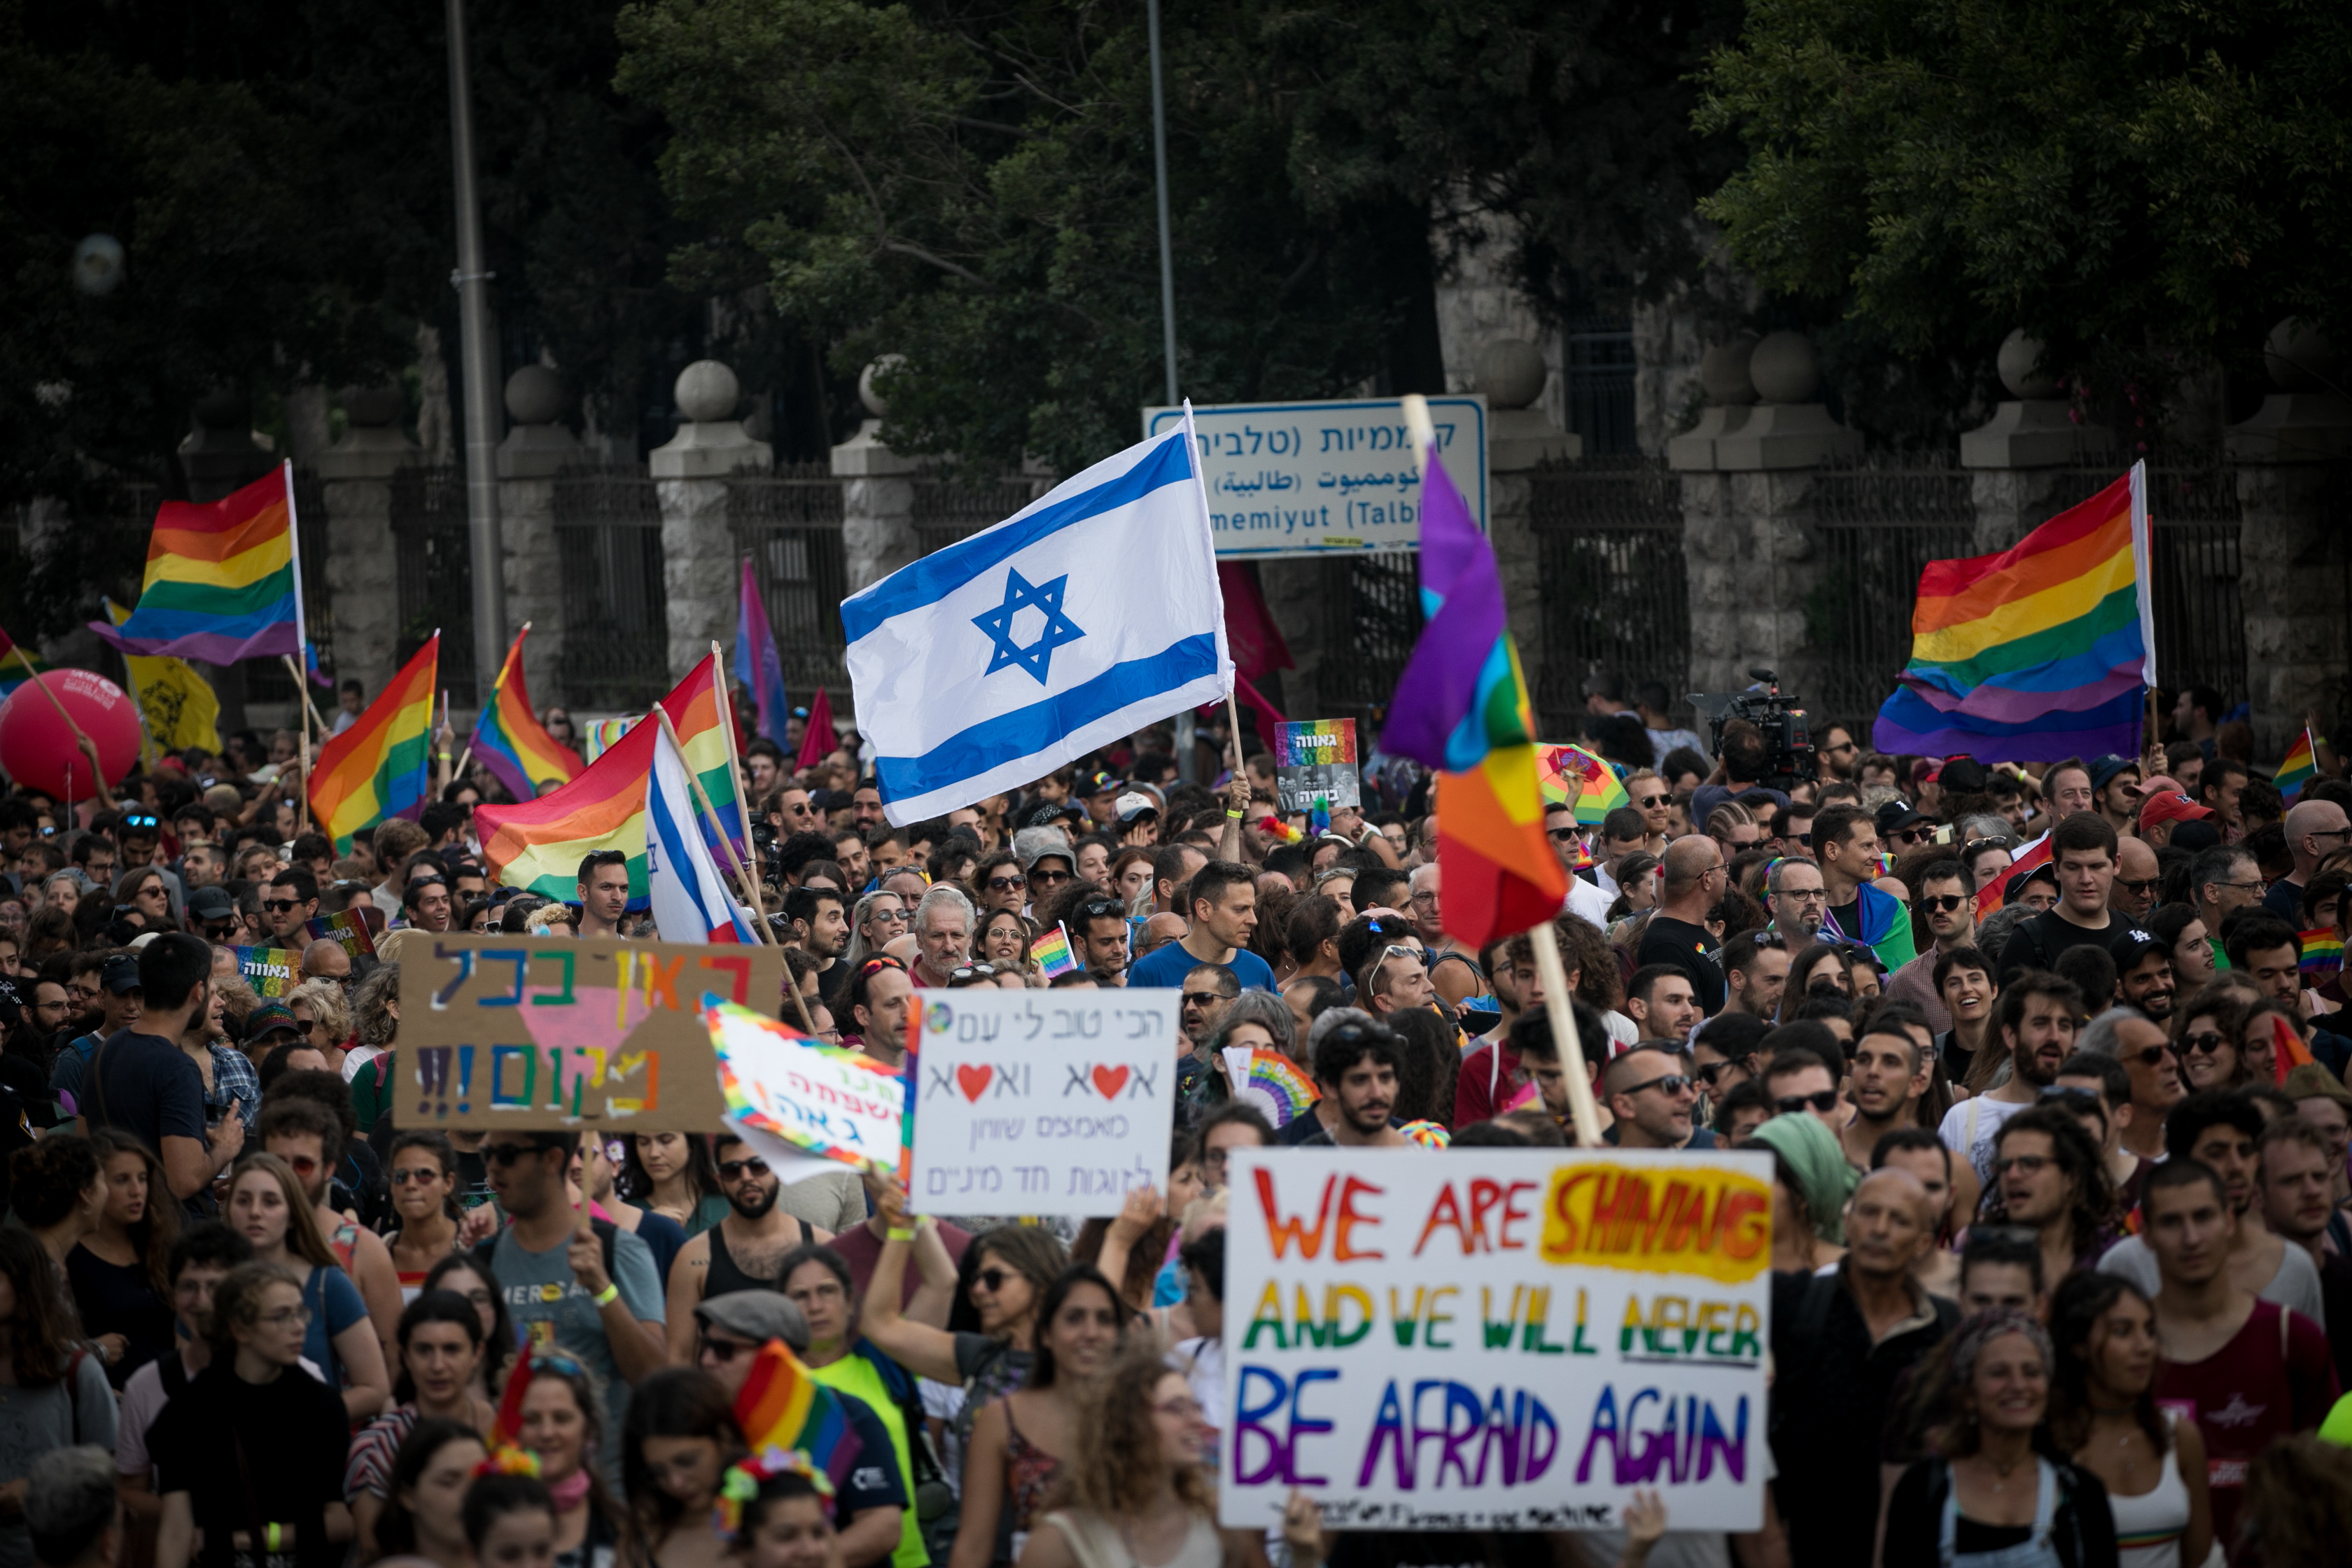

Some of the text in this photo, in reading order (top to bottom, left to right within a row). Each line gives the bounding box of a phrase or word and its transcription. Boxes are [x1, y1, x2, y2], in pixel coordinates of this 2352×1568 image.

[1320, 422, 1455, 454] קממיות
[1210, 499, 1423, 534] memiyut (Talbi
[1296, 734, 1338, 748] גאווה
[2129, 929, 2151, 943] LA
[244, 962, 290, 979] גאווה
[956, 998, 1164, 1044] הכי טוב לי עם
[1012, 1165, 1051, 1194] חד
[1252, 1166, 1387, 1262] WE
[1412, 1177, 1539, 1256] ARE
[1240, 1278, 1762, 1359] AND WE WILL NEVER
[1233, 1364, 1751, 1491] BE AFRAID AGAIN
